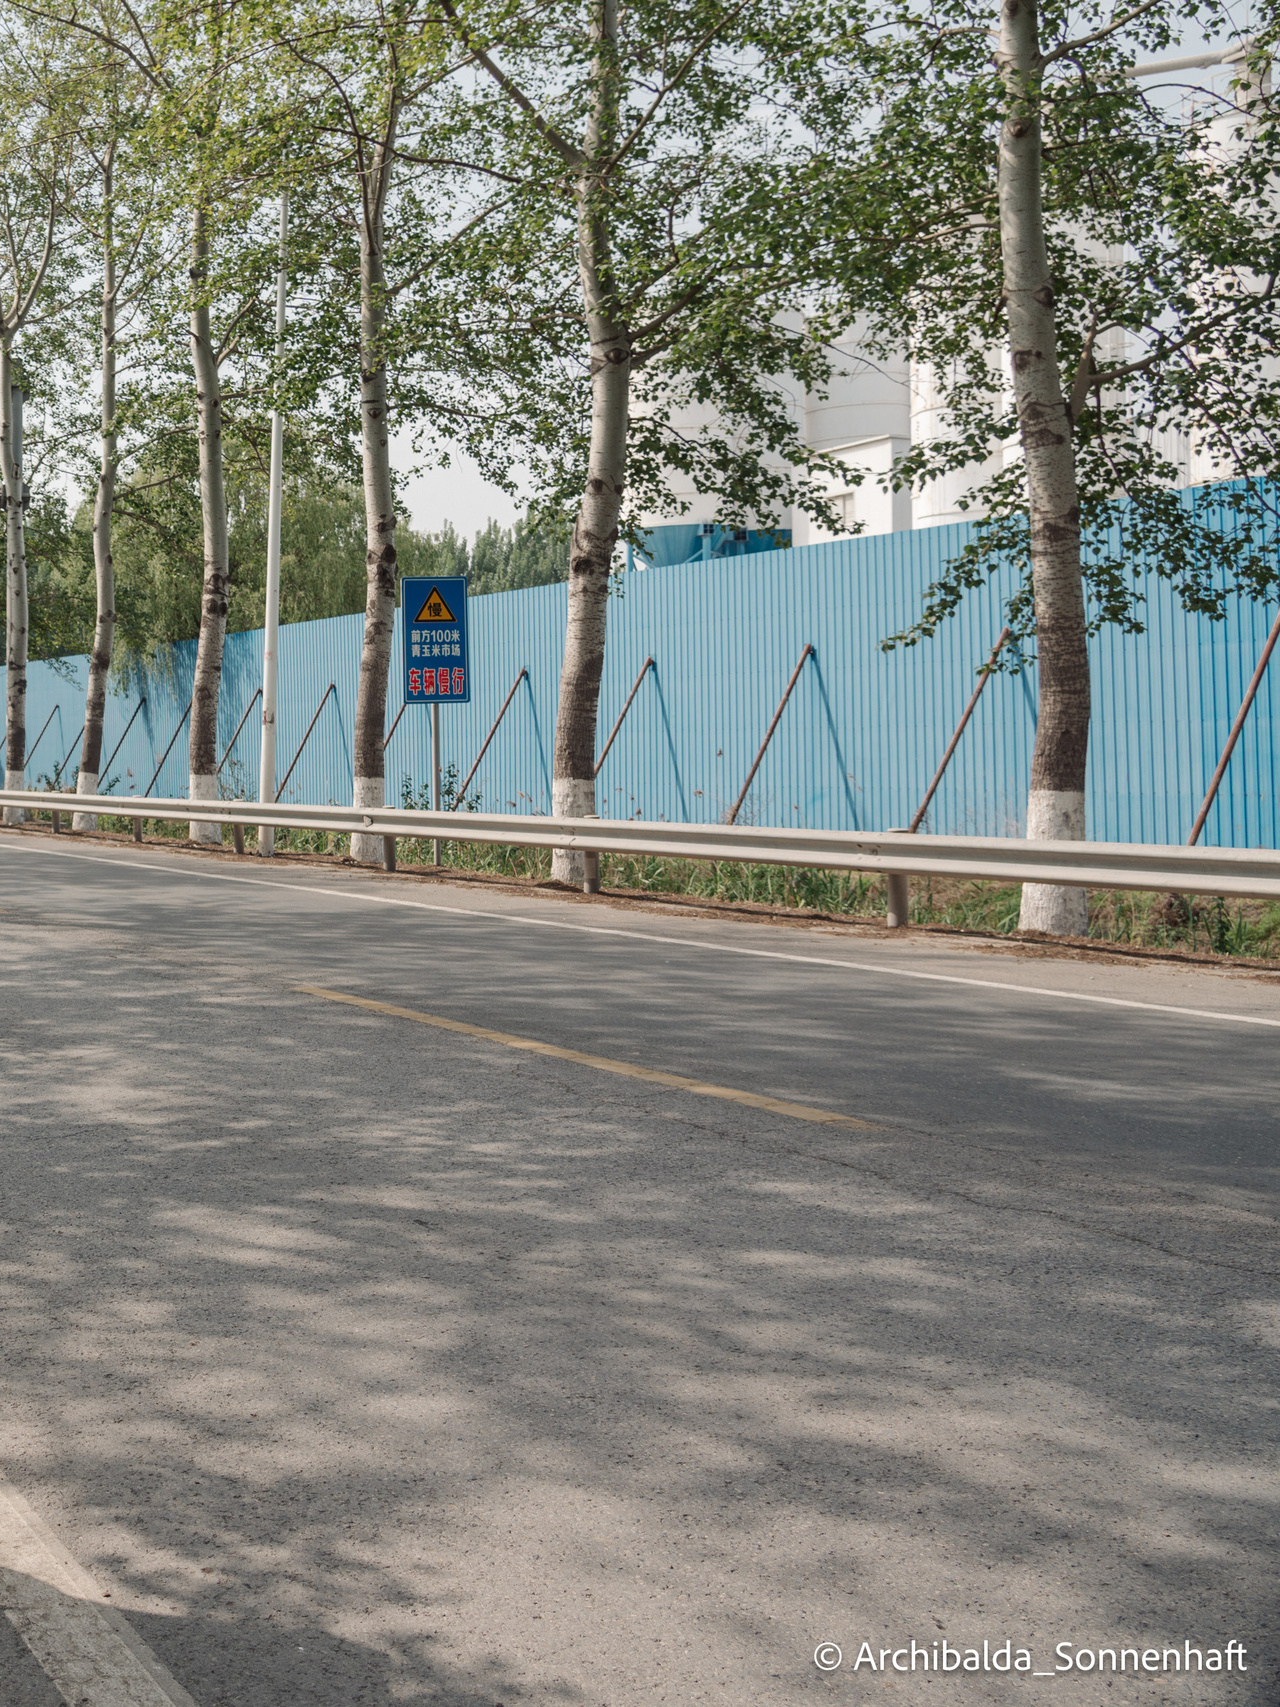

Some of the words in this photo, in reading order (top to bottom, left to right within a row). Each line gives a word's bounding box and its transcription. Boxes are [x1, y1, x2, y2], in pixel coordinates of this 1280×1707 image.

[427, 602, 442, 617] 慢
[411, 629, 461, 643] 前方100米
[408, 667, 465, 696] 车辆慢行
